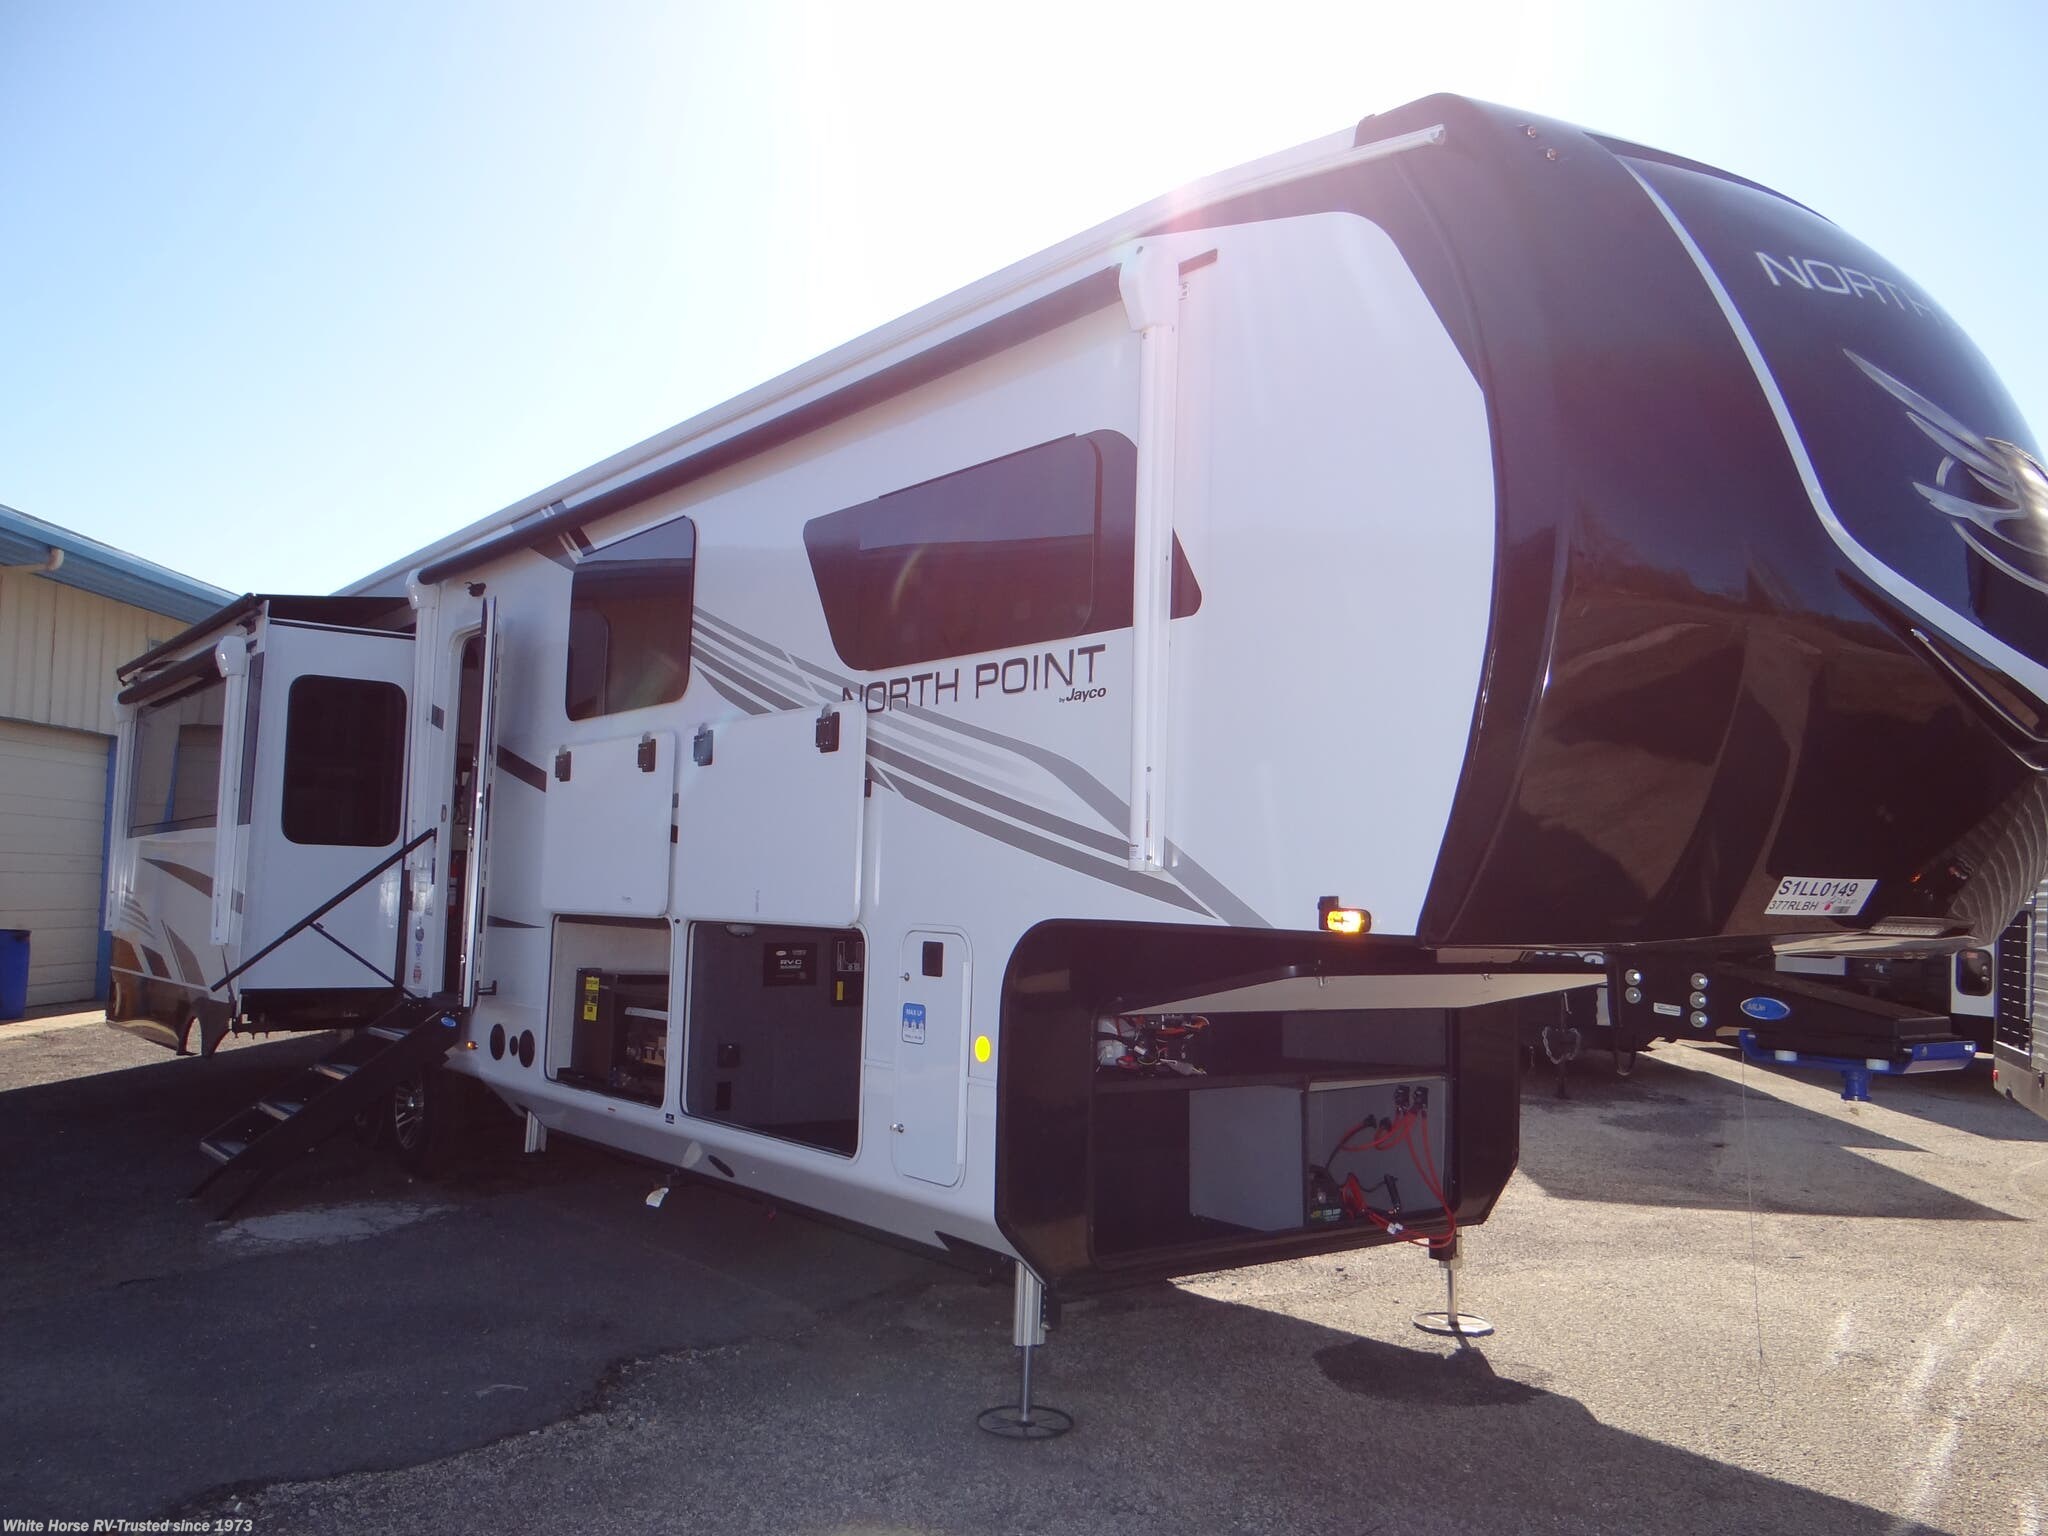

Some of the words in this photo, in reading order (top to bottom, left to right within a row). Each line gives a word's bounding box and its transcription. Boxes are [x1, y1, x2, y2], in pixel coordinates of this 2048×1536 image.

[1755, 251, 1944, 327] NORTH
[975, 643, 1107, 699] POINT
[1066, 687, 1107, 702] Jayco
[1778, 880, 1859, 897] S1LL0149
[1768, 900, 1819, 911] 377RLBH
